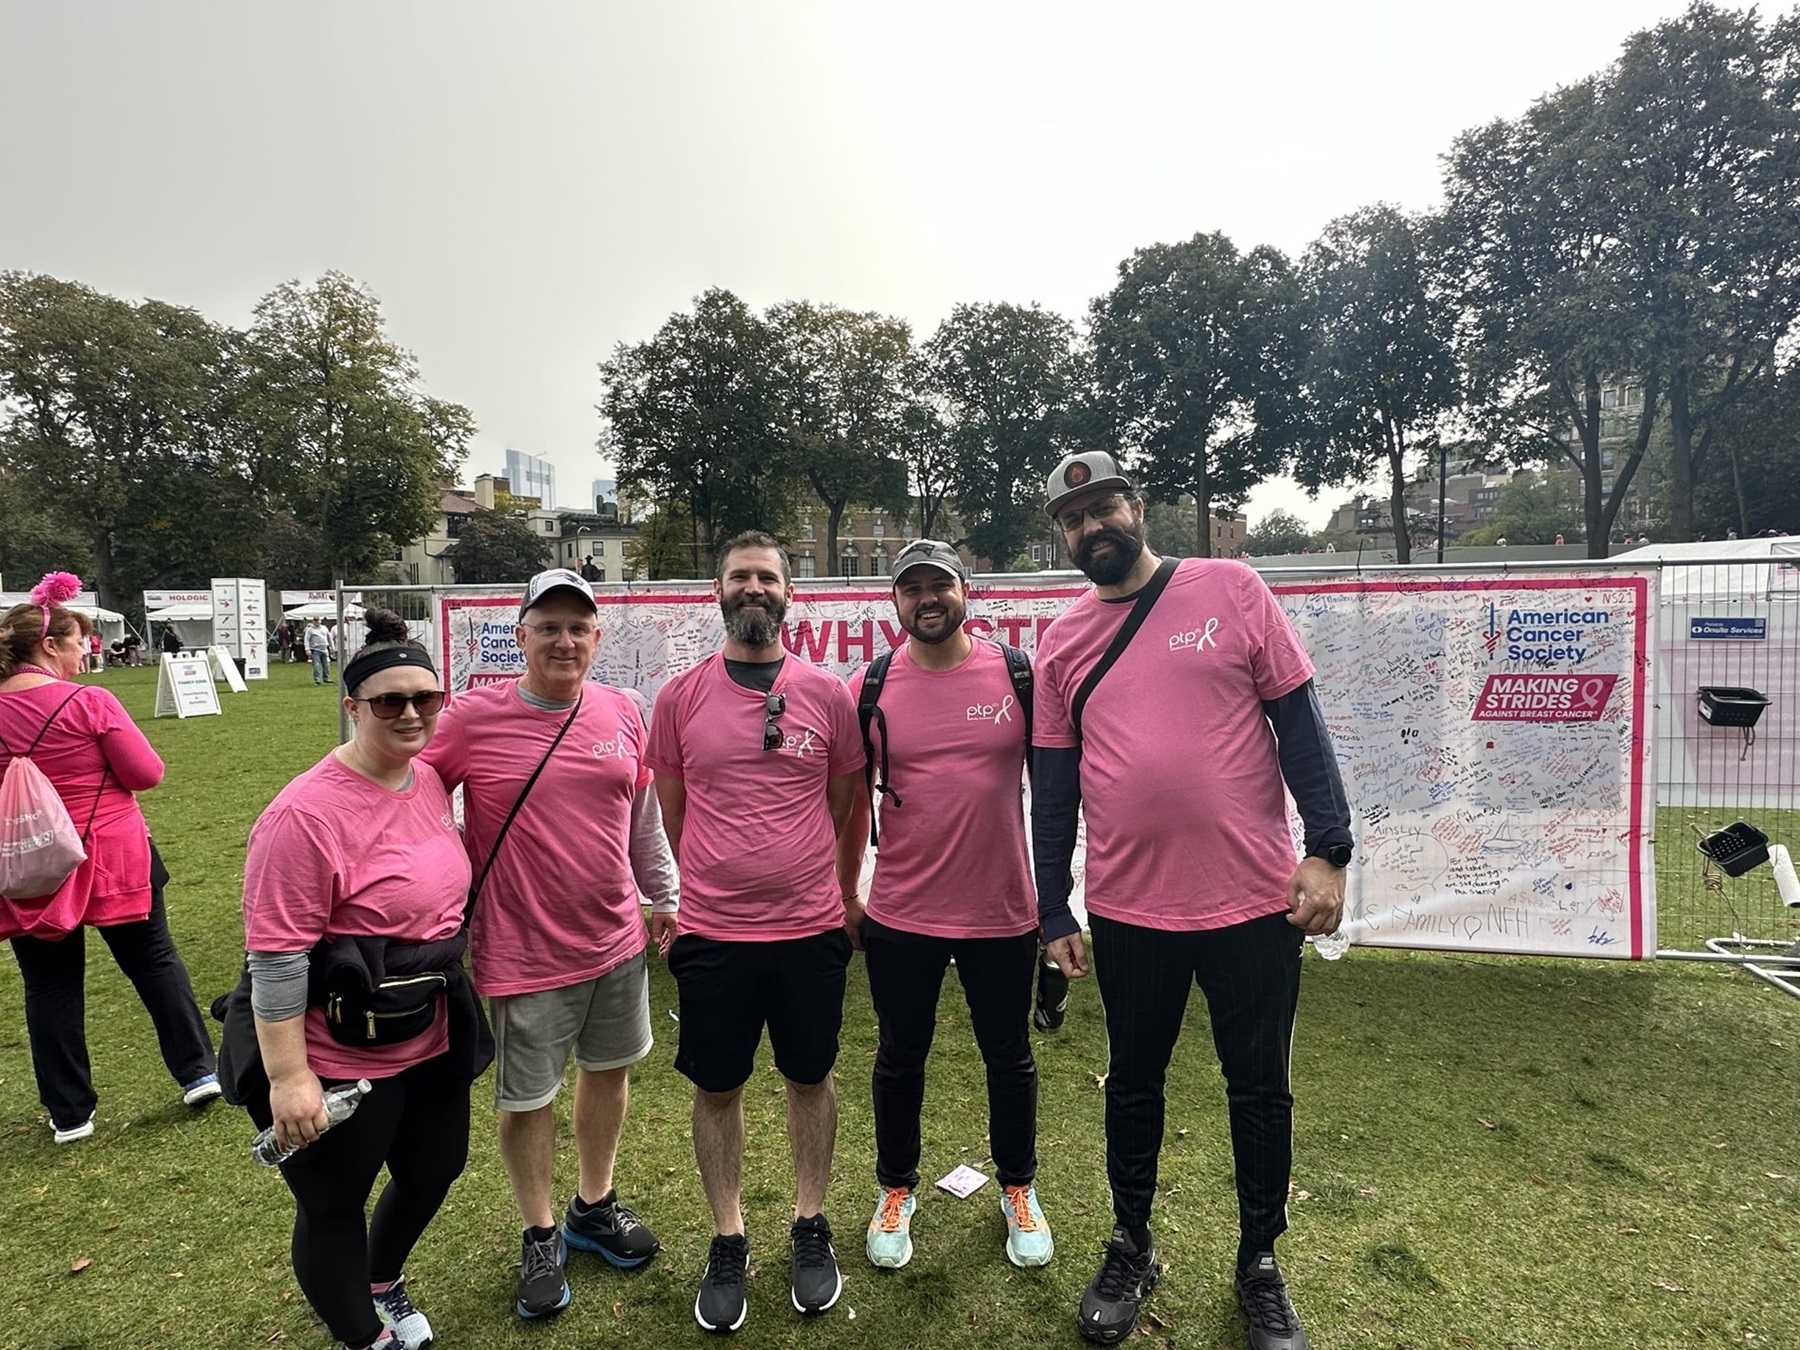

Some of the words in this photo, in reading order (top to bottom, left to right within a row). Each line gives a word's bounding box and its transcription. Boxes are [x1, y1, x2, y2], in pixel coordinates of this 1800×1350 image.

[1507, 609, 1609, 625] American
[481, 622, 516, 634] Amer
[1507, 626, 1584, 642] Cancer
[1730, 626, 1764, 634] Services
[480, 636, 516, 648] Canc
[780, 620, 910, 663] WHY
[1169, 631, 1196, 651] ptp
[481, 650, 525, 663] Societ
[1508, 645, 1586, 662] Society
[1491, 679, 1579, 693] MAKING
[1486, 694, 1572, 709] STRIDES
[967, 703, 994, 720] ptp
[1478, 710, 1518, 718] AGAINST
[1520, 710, 1554, 718] BREAST
[1392, 904, 1460, 937] FAMILY
